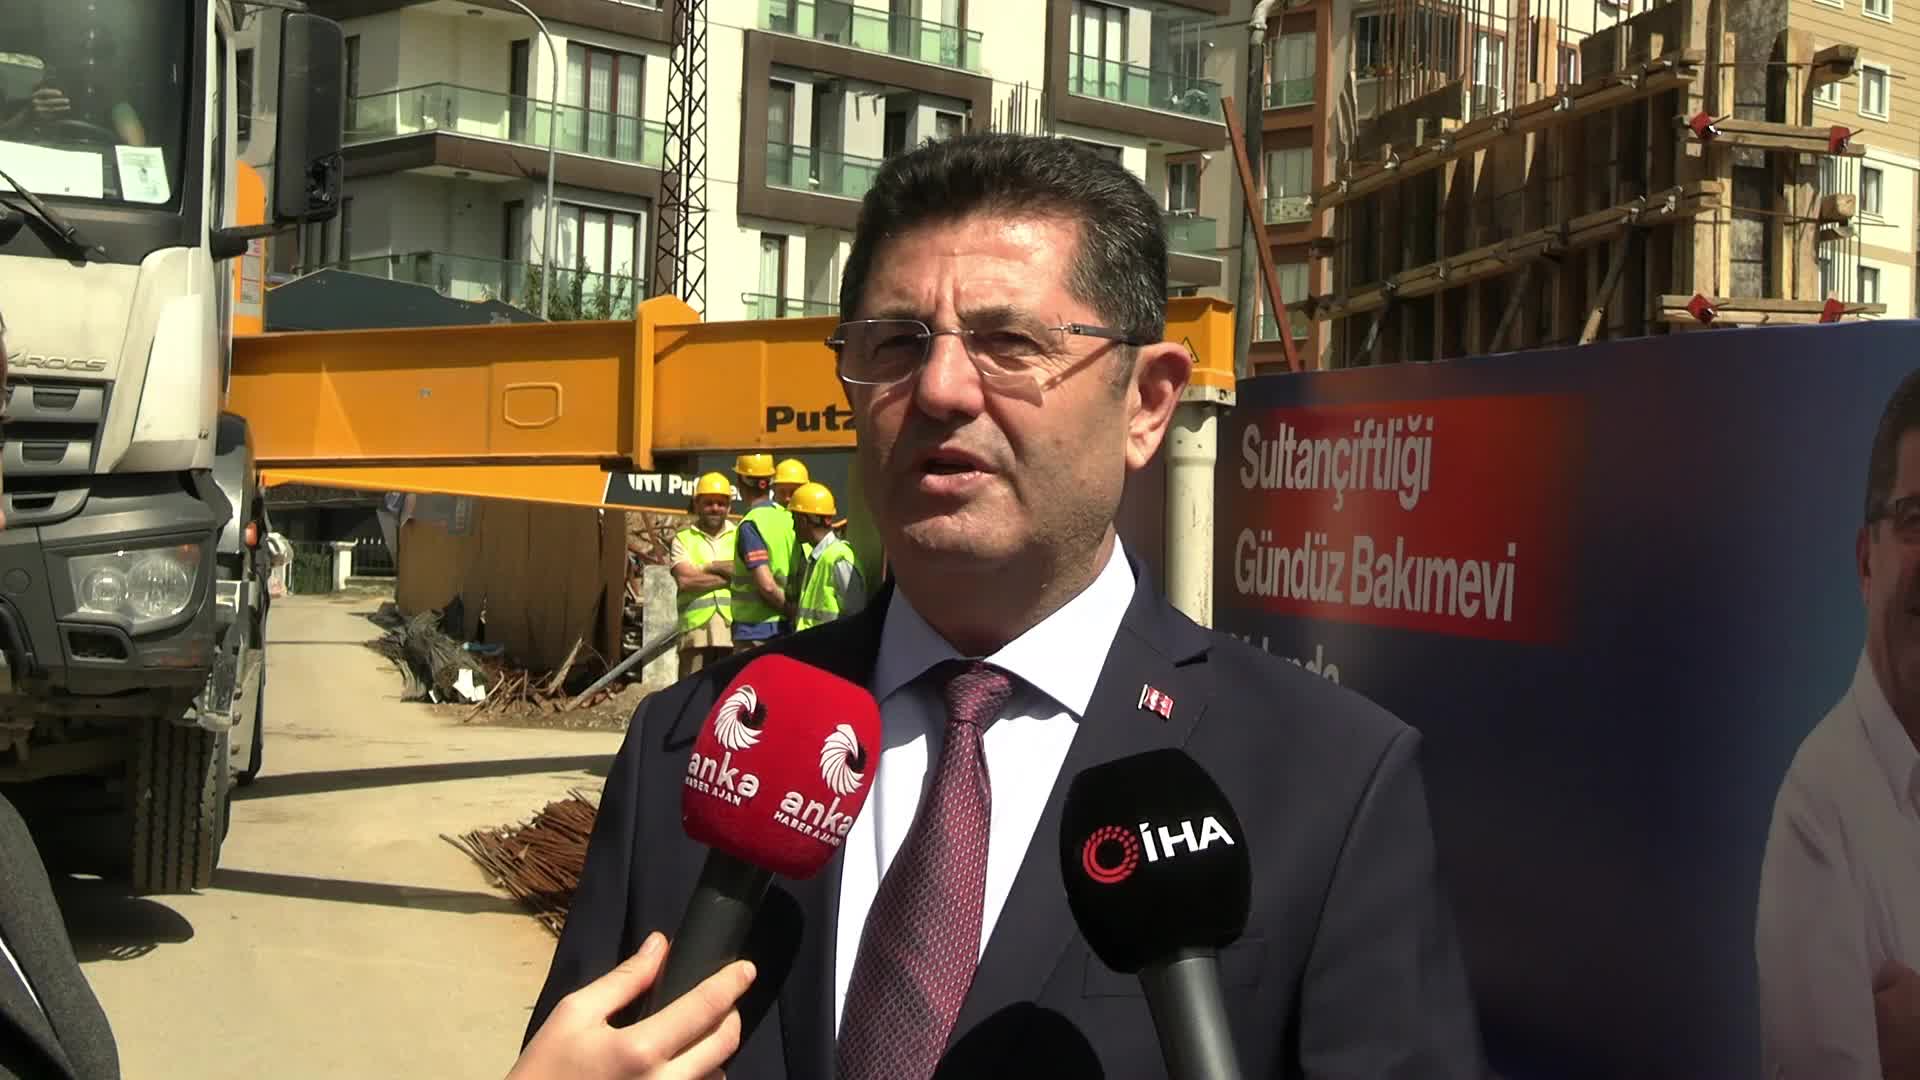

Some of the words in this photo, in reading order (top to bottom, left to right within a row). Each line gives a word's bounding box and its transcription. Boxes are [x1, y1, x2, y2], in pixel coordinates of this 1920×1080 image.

[1240, 414, 1433, 510] Sultançiftliği
[1235, 528, 1345, 604] Gündüz
[1350, 535, 1517, 622] Bakımevi
[687, 751, 760, 798] anka
[773, 811, 813, 835] HABER
[780, 791, 854, 836] anka
[1139, 816, 1235, 862] İHA
